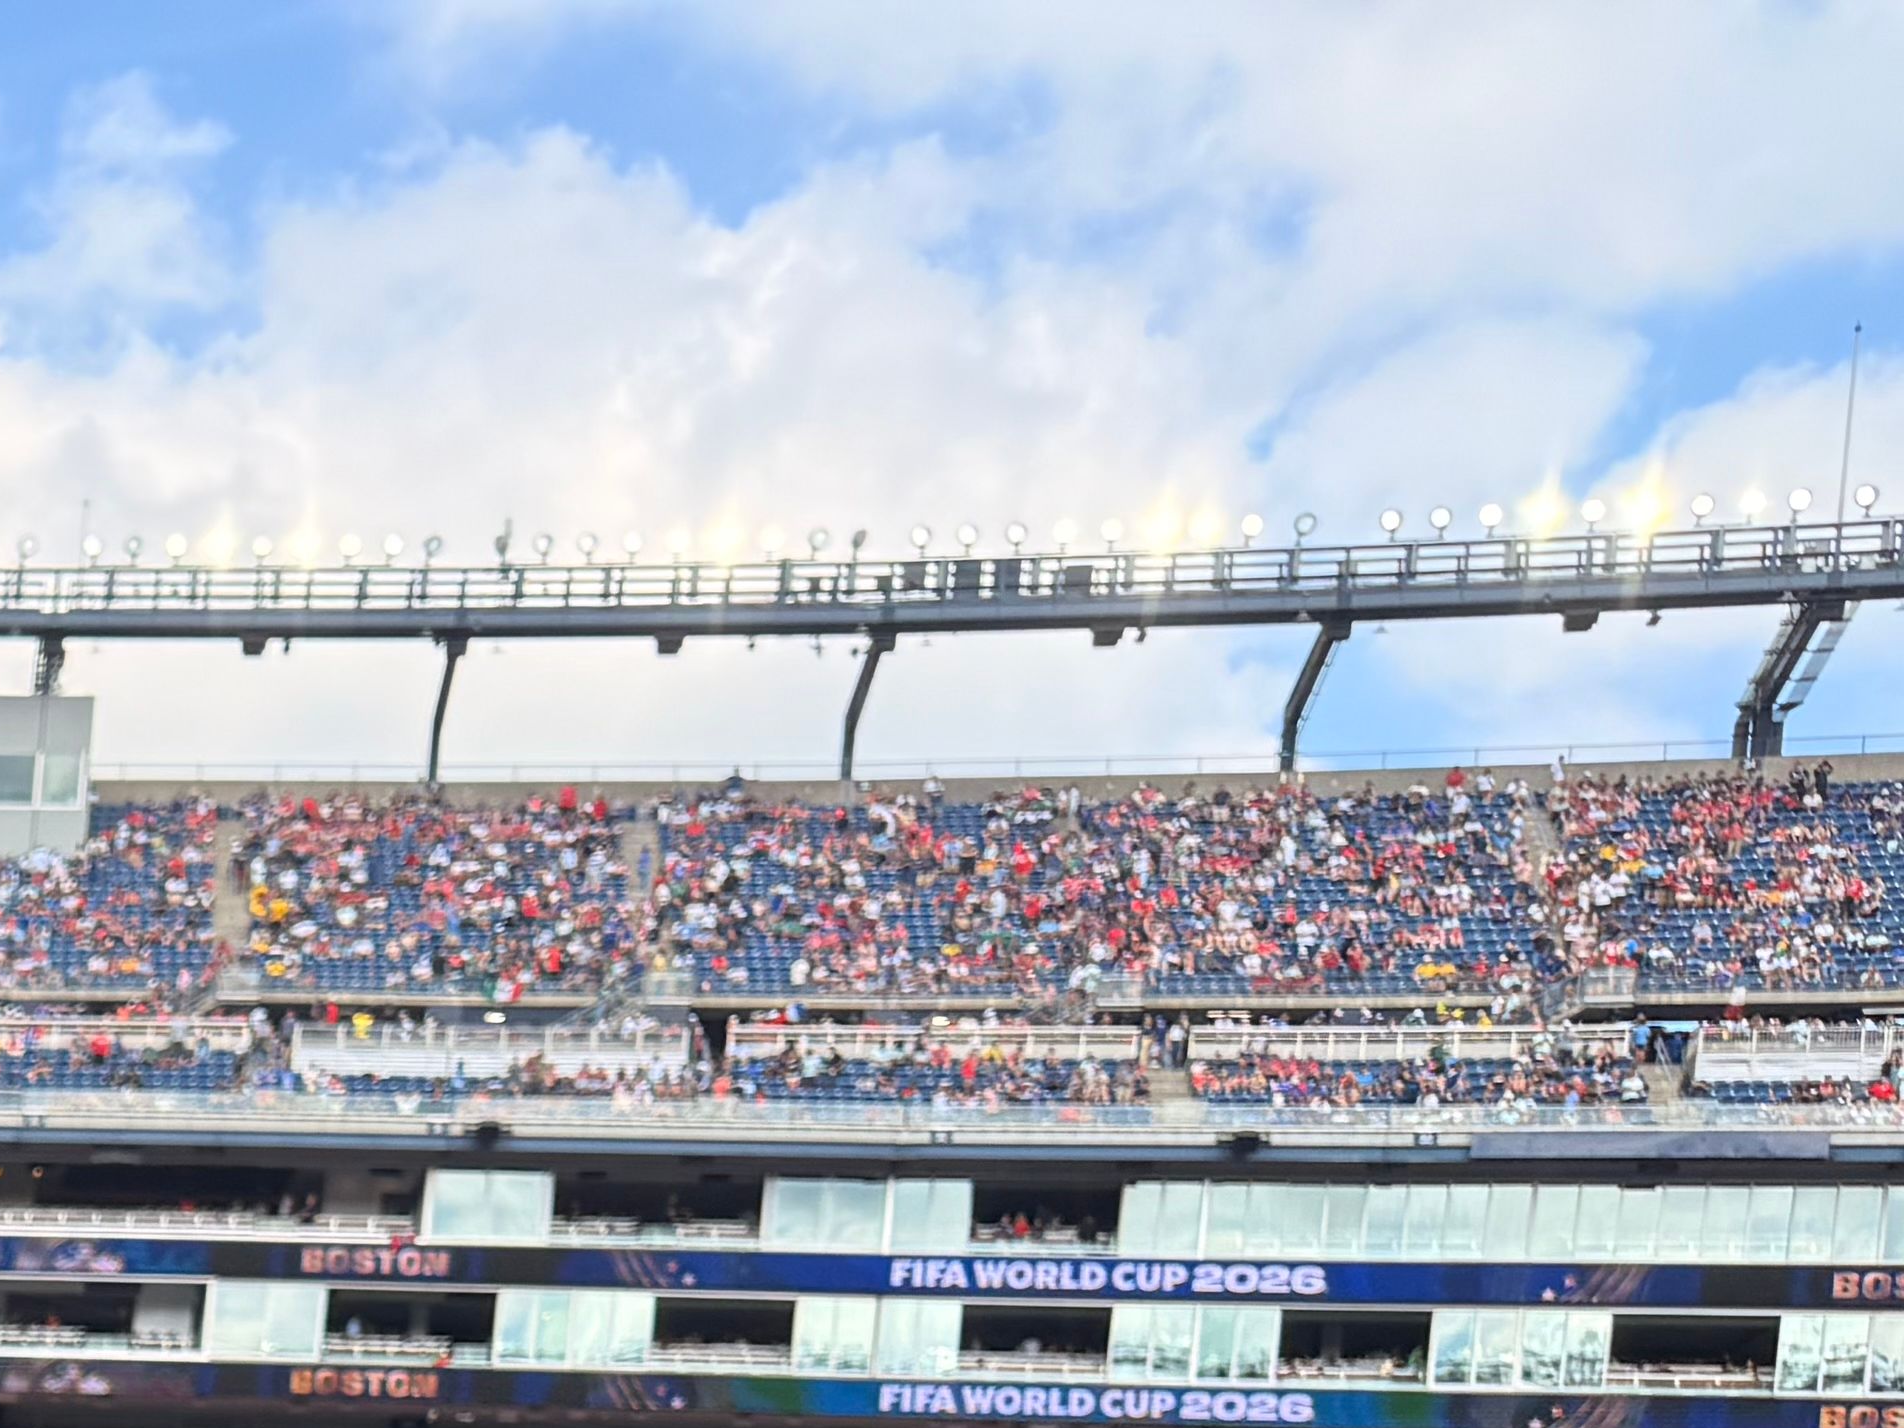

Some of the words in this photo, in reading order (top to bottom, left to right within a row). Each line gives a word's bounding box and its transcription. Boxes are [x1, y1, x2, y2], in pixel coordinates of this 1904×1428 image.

[301, 1247, 450, 1277] BOSTON
[891, 1258, 967, 1289] FIFA
[973, 1259, 1106, 1292] WORLD
[1111, 1263, 1188, 1293] CUP
[1192, 1264, 1328, 1295] 2026
[290, 1367, 439, 1398] BOSTON
[879, 1383, 957, 1413] FIFA
[961, 1385, 1093, 1417] WORLD
[1099, 1389, 1176, 1419] CUP
[1180, 1392, 1315, 1423] 2026
